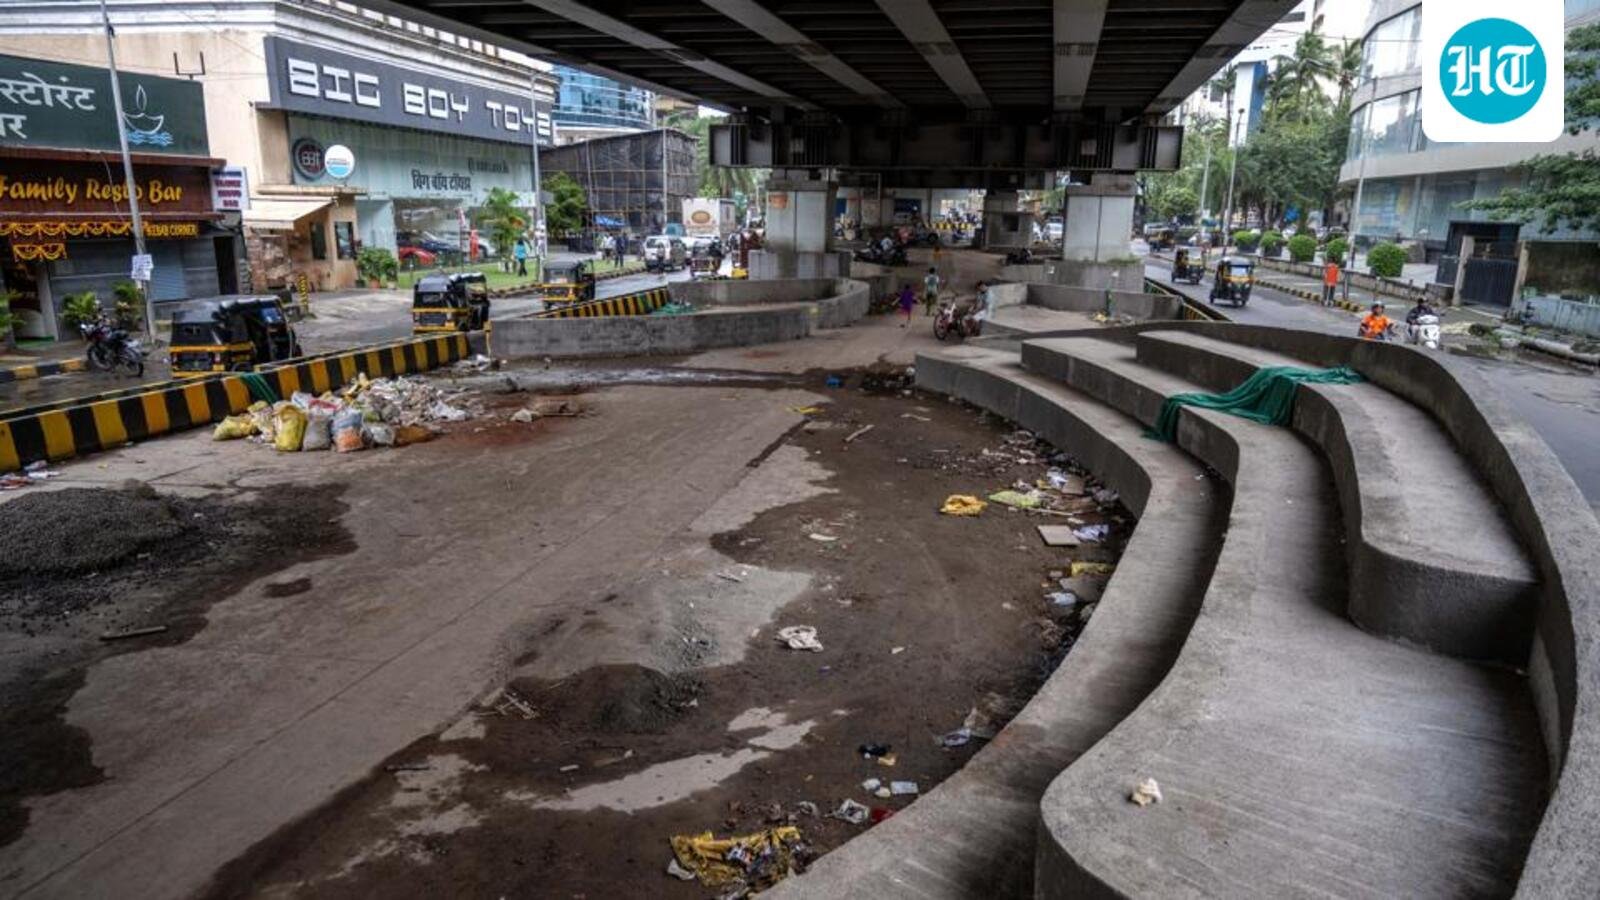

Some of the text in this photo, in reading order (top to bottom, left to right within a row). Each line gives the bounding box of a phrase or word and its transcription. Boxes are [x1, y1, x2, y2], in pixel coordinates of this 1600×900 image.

[287, 57, 381, 108] BIG
[403, 82, 469, 122] BOY
[0, 176, 77, 204] Family
[149, 180, 183, 204] Bar
[411, 168, 430, 190] बिग
